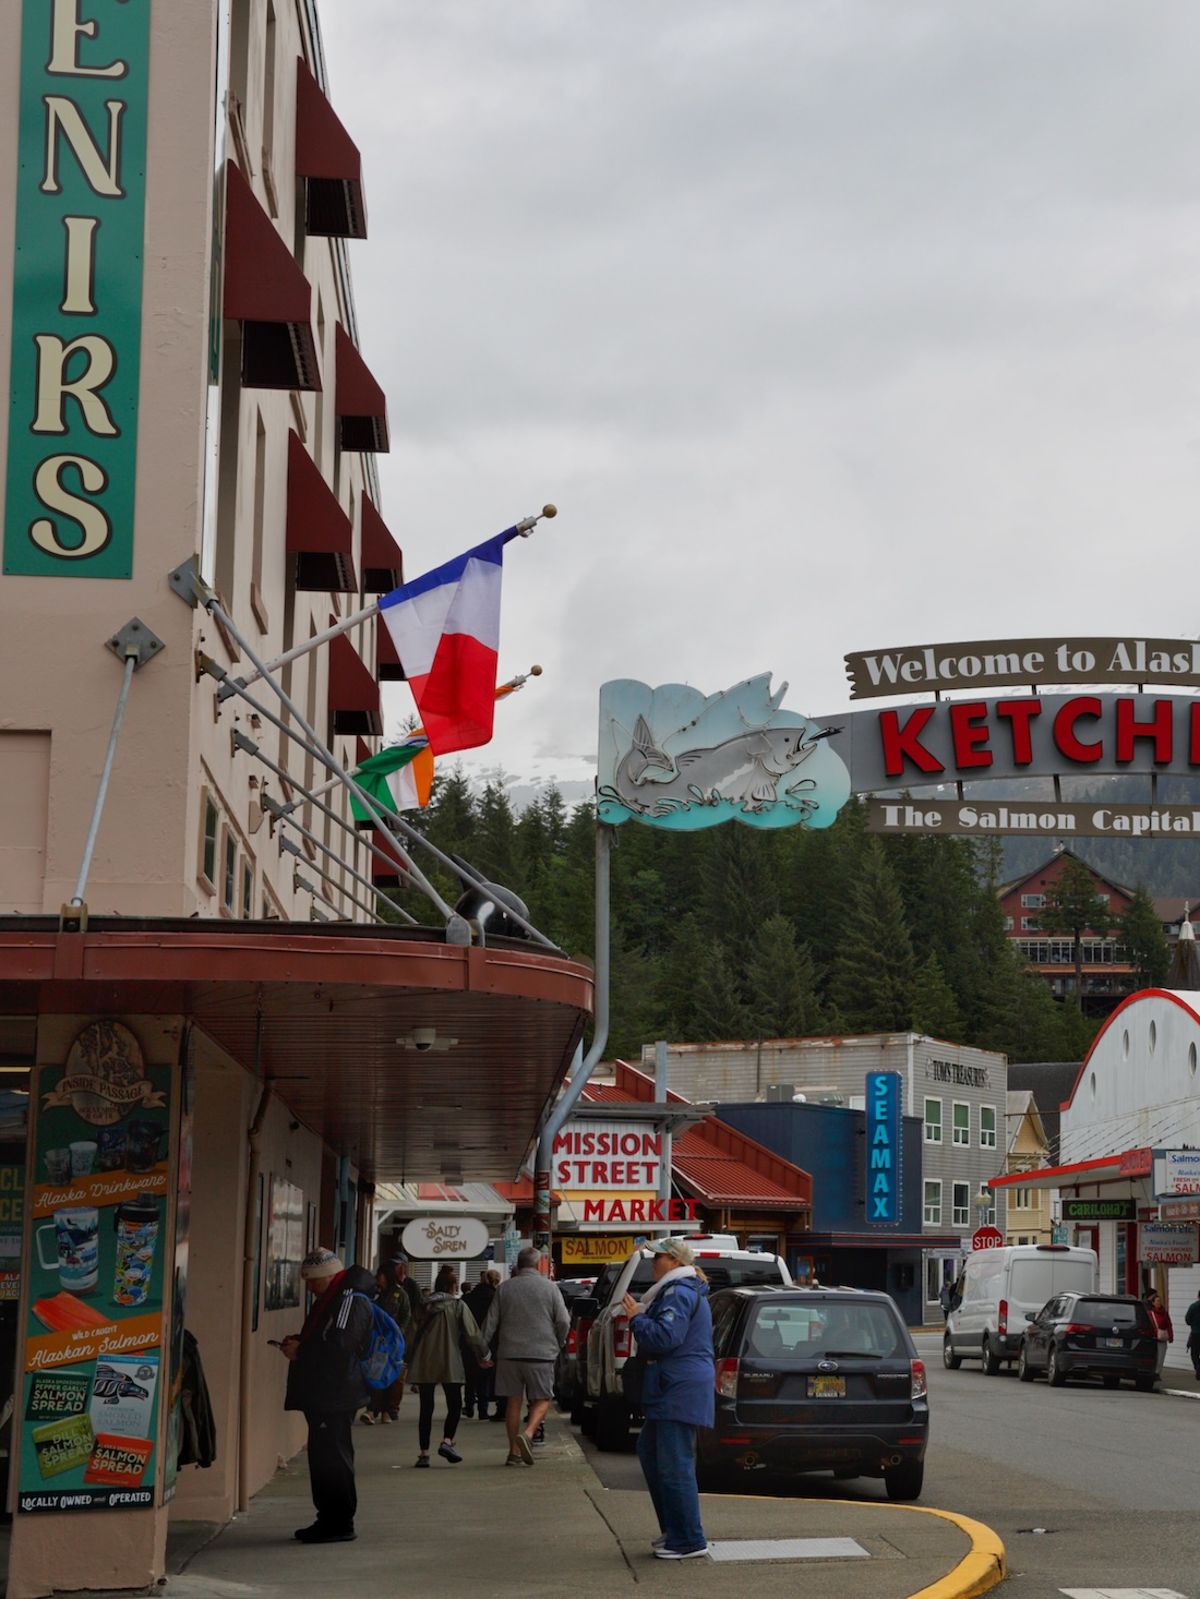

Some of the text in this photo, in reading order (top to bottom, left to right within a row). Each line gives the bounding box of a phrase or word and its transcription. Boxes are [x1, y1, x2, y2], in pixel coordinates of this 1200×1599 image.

[862, 646, 1044, 686] Welcome
[1057, 644, 1096, 672] to
[880, 805, 942, 828] The
[958, 806, 1076, 831] Salmon
[1092, 808, 1200, 838] Capital
[63, 1077, 144, 1099] INSIDE PASSAGE
[552, 1132, 662, 1156] MISSION
[871, 1075, 891, 1218] SEAMAX
[558, 1160, 659, 1184] STREET
[34, 1175, 166, 1208] Alaska Drinkware
[584, 1197, 700, 1222] MARKET
[426, 1221, 461, 1239] SALTY
[433, 1238, 467, 1254] SIREN
[565, 1239, 628, 1257] SALMON
[974, 1235, 1002, 1250] STOP
[1146, 1252, 1191, 1262] SALMON
[28, 1332, 159, 1367] Alaskan Salmon
[31, 1400, 84, 1411] SPREAD
[33, 1390, 86, 1401] SALMON
[41, 1433, 93, 1457] SALMON
[45, 1443, 94, 1468] SPREAD
[91, 1461, 144, 1475] SPREAD
[95, 1449, 147, 1465] SALMON
[21, 1497, 58, 1511] LOCALLY
[60, 1495, 92, 1508] OWNED
[109, 1492, 152, 1506] OPERATED
